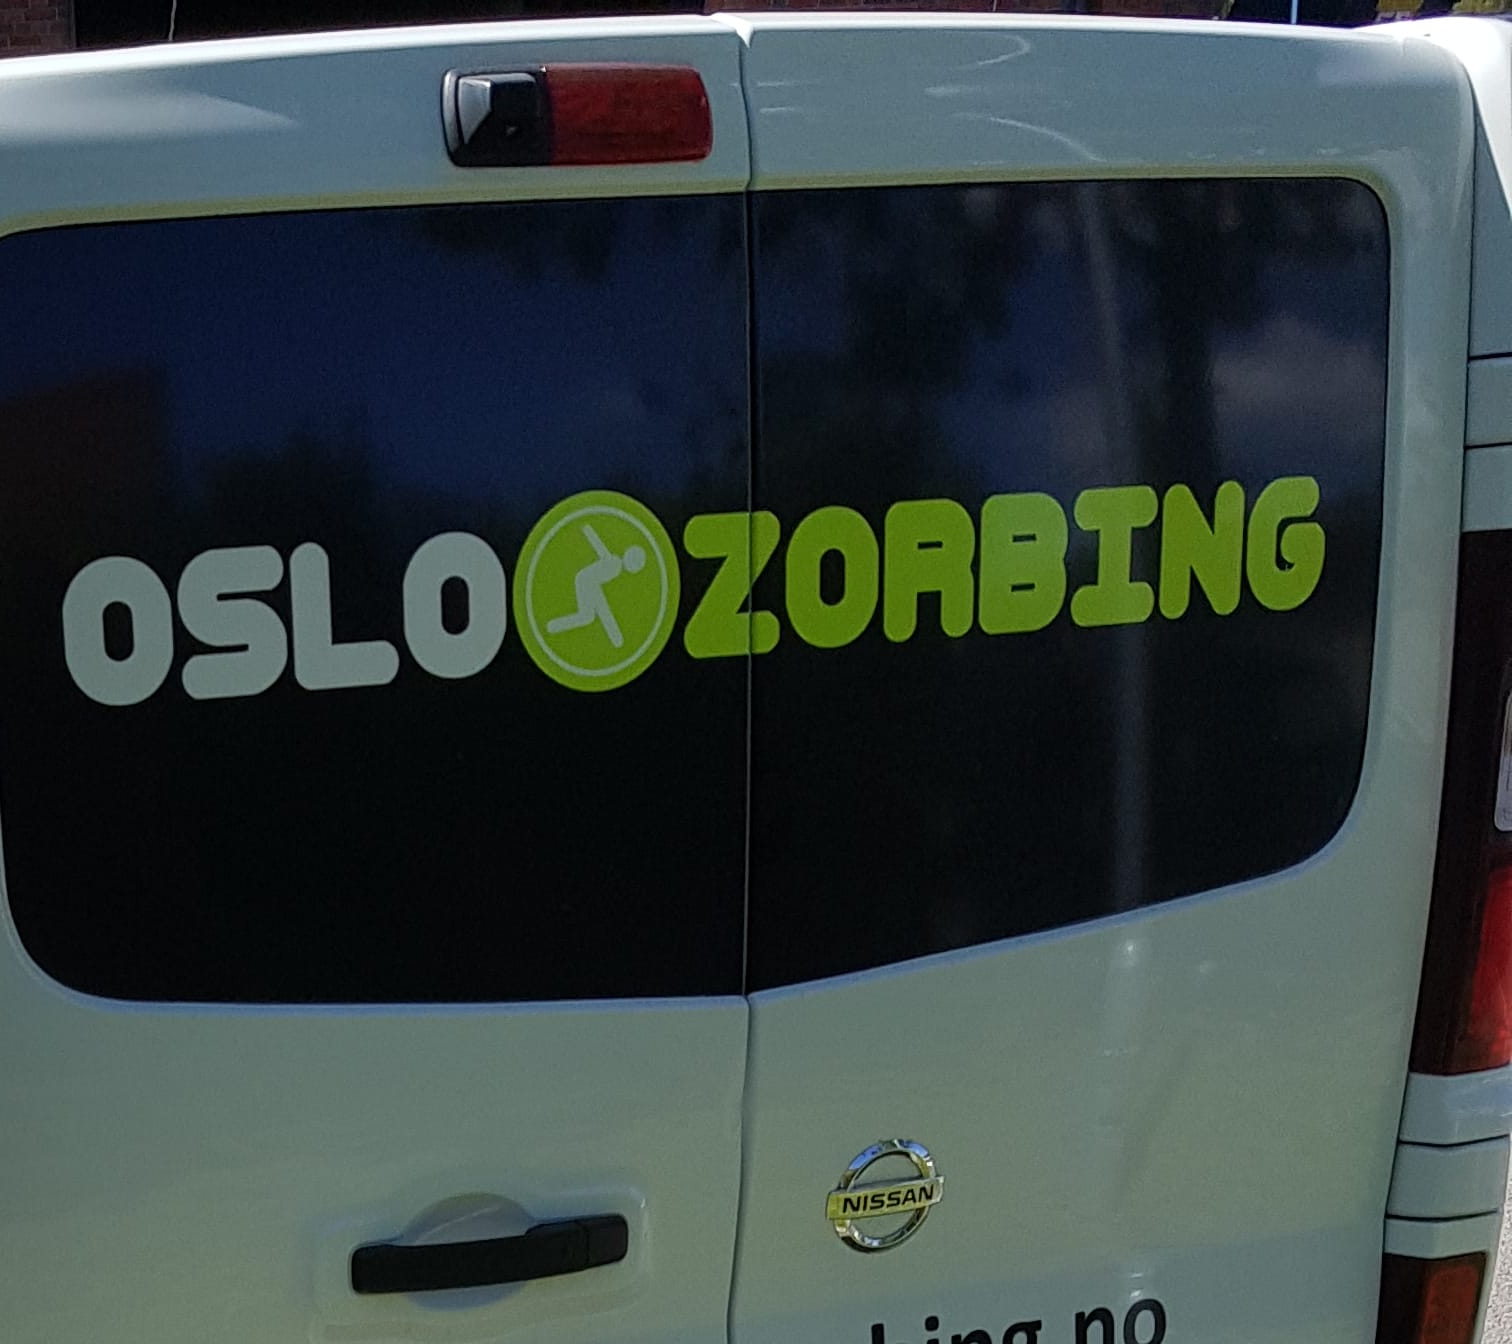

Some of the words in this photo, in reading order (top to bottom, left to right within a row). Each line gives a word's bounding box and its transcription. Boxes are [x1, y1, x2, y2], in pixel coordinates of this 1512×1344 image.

[62, 531, 507, 706] OSLO
[683, 476, 1326, 659] ZORBING
[842, 1184, 934, 1214] NISSAN
